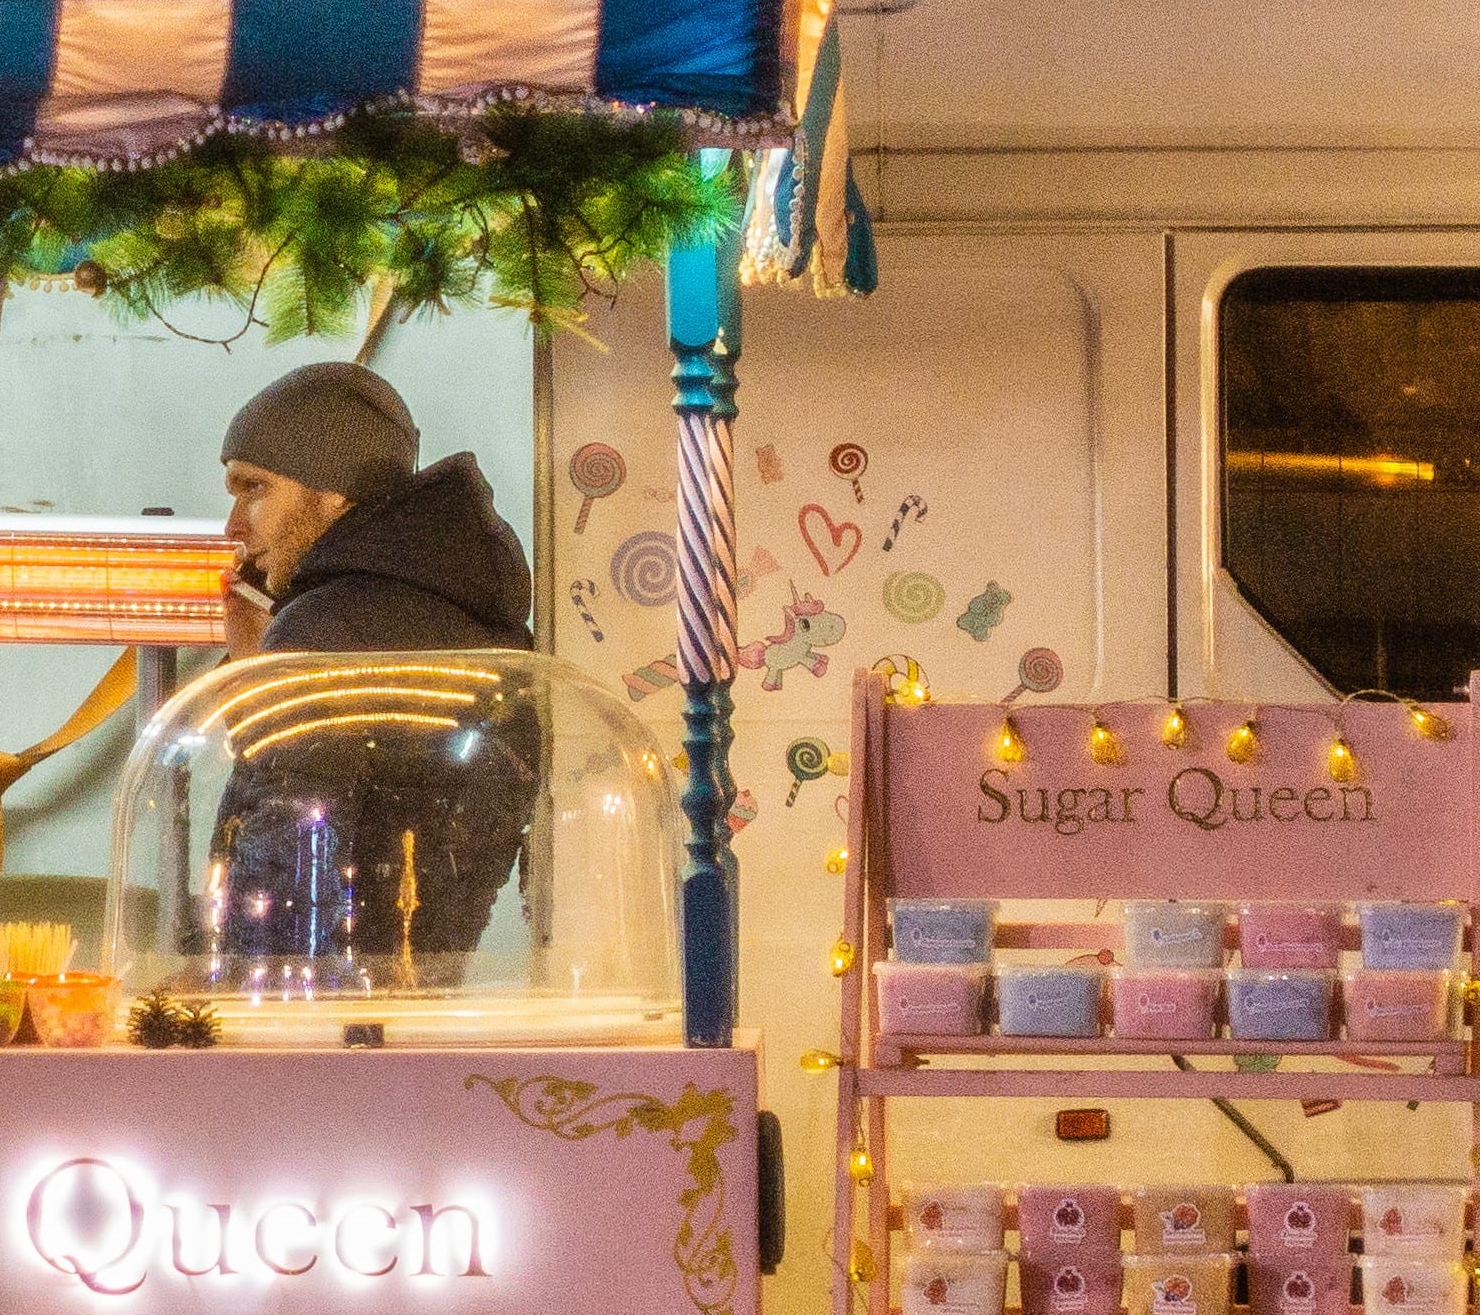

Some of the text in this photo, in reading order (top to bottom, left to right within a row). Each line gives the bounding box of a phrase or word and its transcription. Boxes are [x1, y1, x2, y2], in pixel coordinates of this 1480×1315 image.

[977, 767, 1378, 835] Sugar Queen
[25, 1156, 495, 1297] Queen
